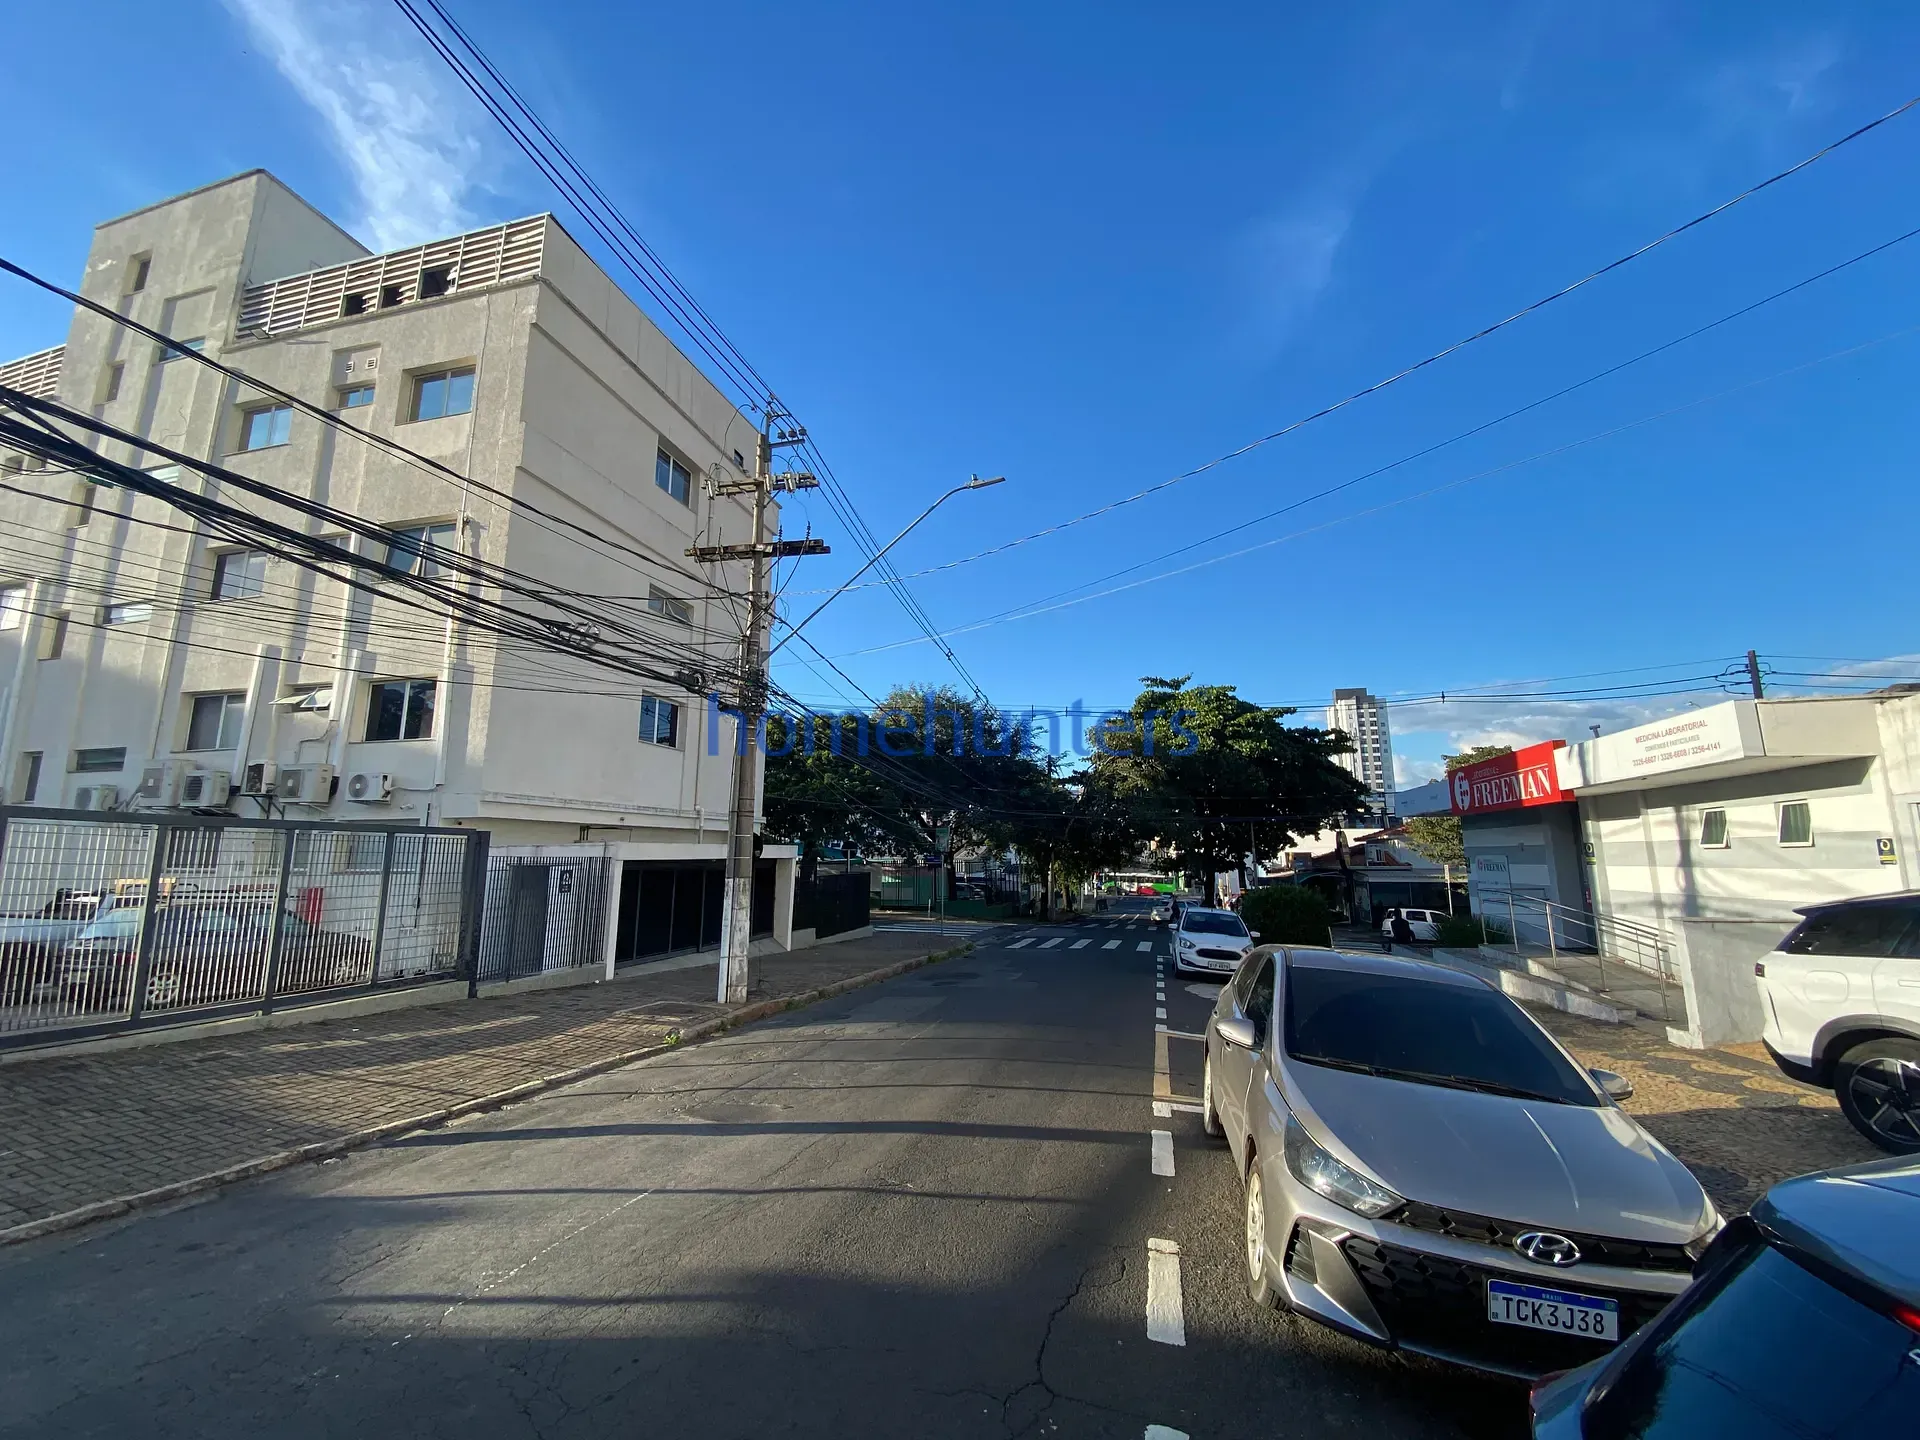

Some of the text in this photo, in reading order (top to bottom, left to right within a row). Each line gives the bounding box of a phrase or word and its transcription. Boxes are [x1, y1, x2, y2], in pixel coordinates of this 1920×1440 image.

[1635, 720, 1708, 743] MEDICINA LABORATORIAL
[1691, 741, 1721, 754] 3256-4141
[1473, 768, 1552, 807] FREEMAN
[1502, 1296, 1605, 1335] TCK3J38
